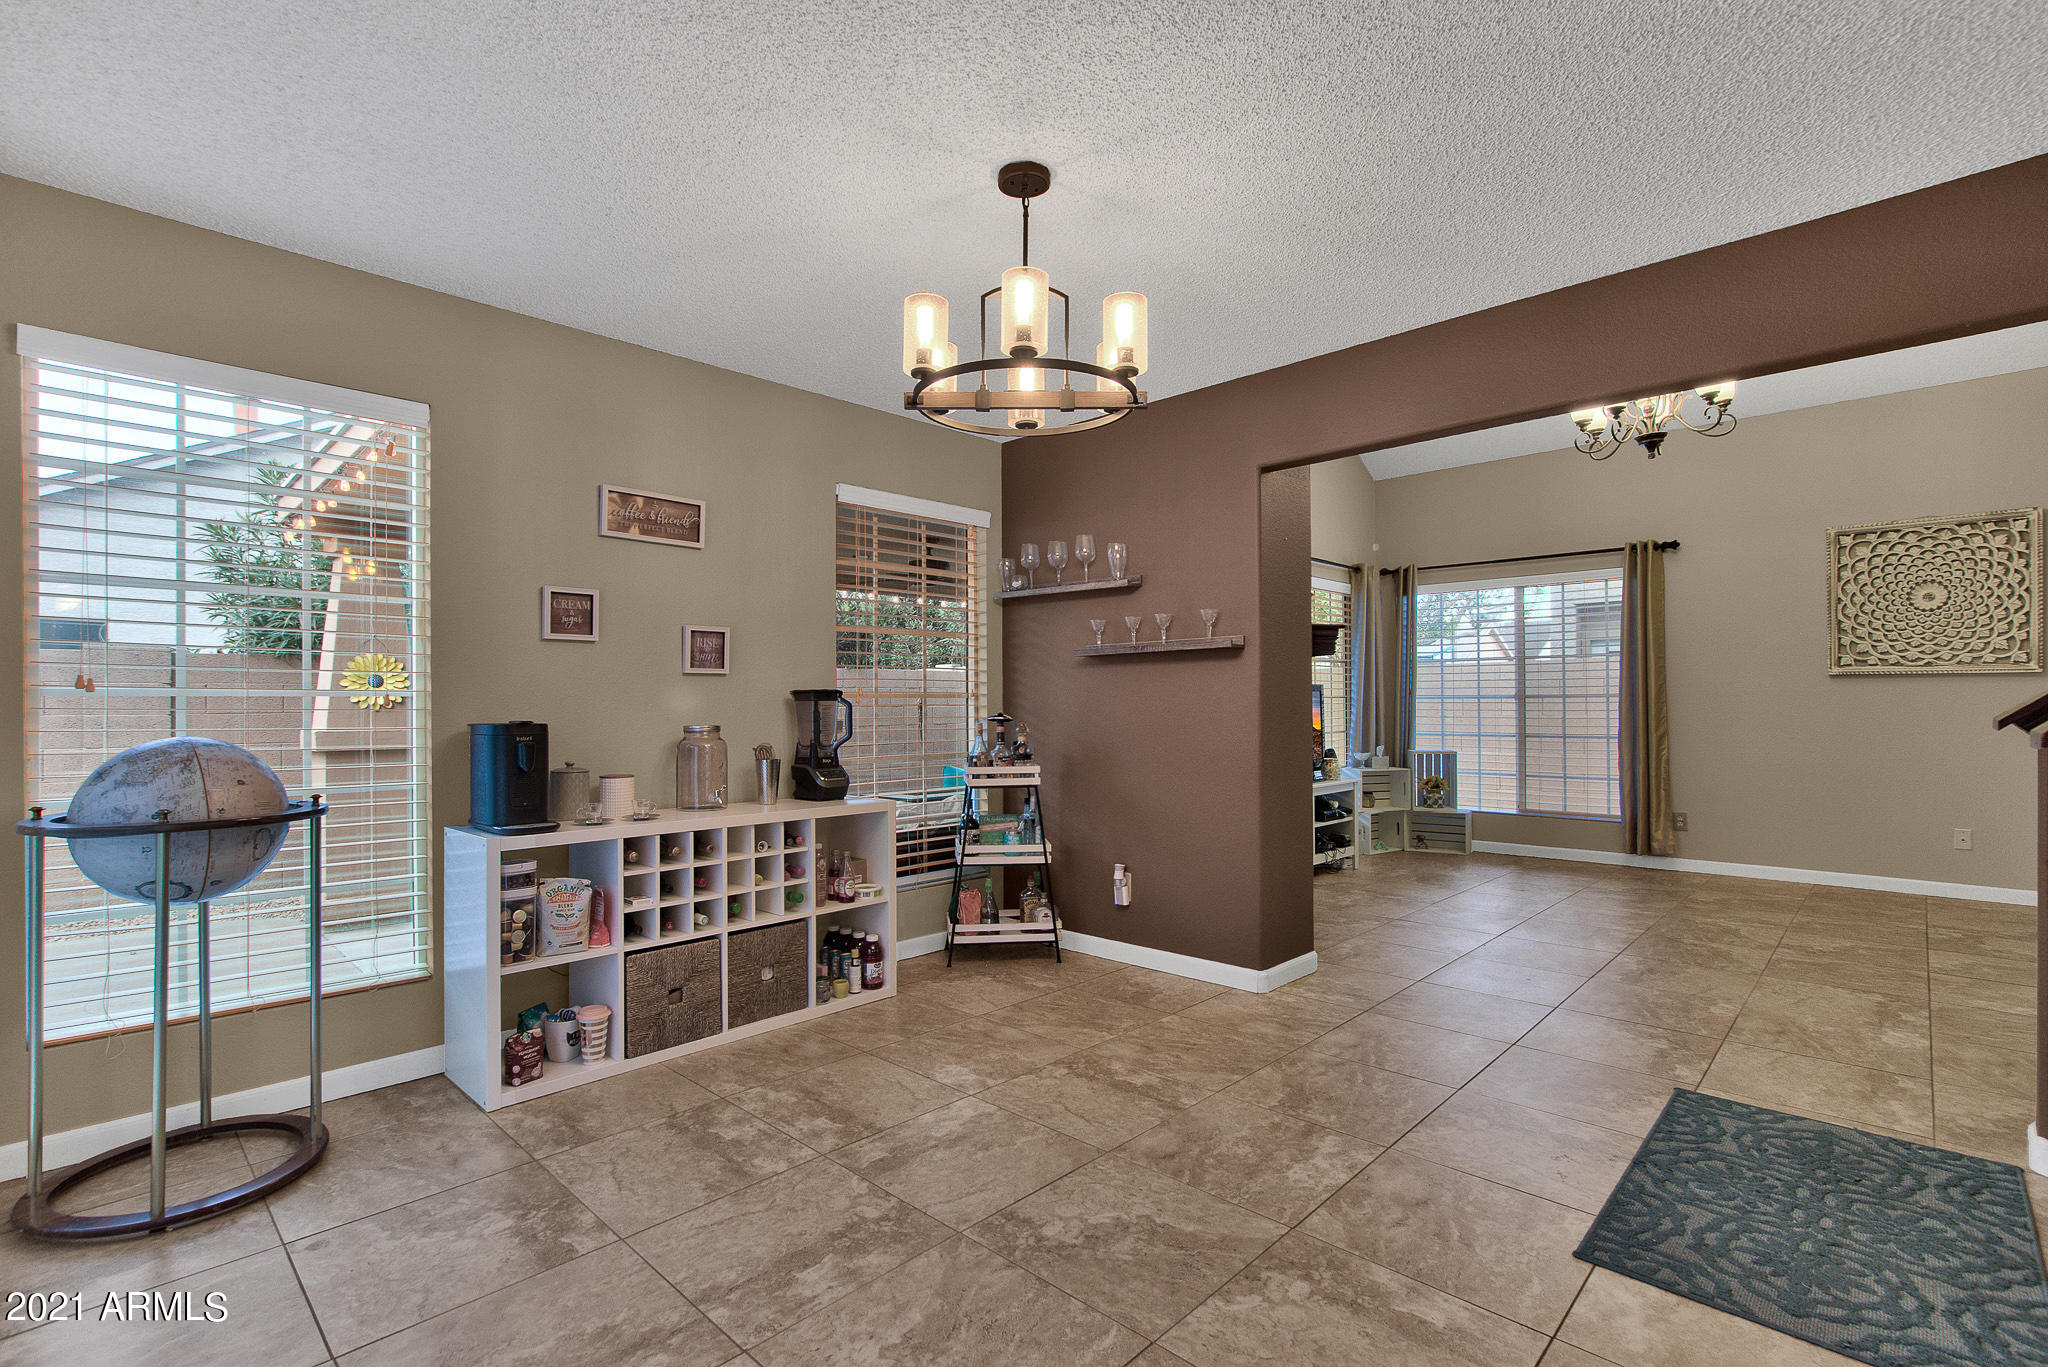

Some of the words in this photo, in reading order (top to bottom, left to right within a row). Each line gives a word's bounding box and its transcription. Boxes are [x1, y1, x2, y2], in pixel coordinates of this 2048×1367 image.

[609, 502, 646, 520] coffee
[648, 511, 656, 520] &
[656, 507, 700, 529] friends
[666, 527, 688, 535] BLEND
[552, 598, 591, 610] CREAM
[560, 615, 584, 629] sugar
[696, 637, 721, 648] RISE
[545, 884, 585, 898] ORGANIC
